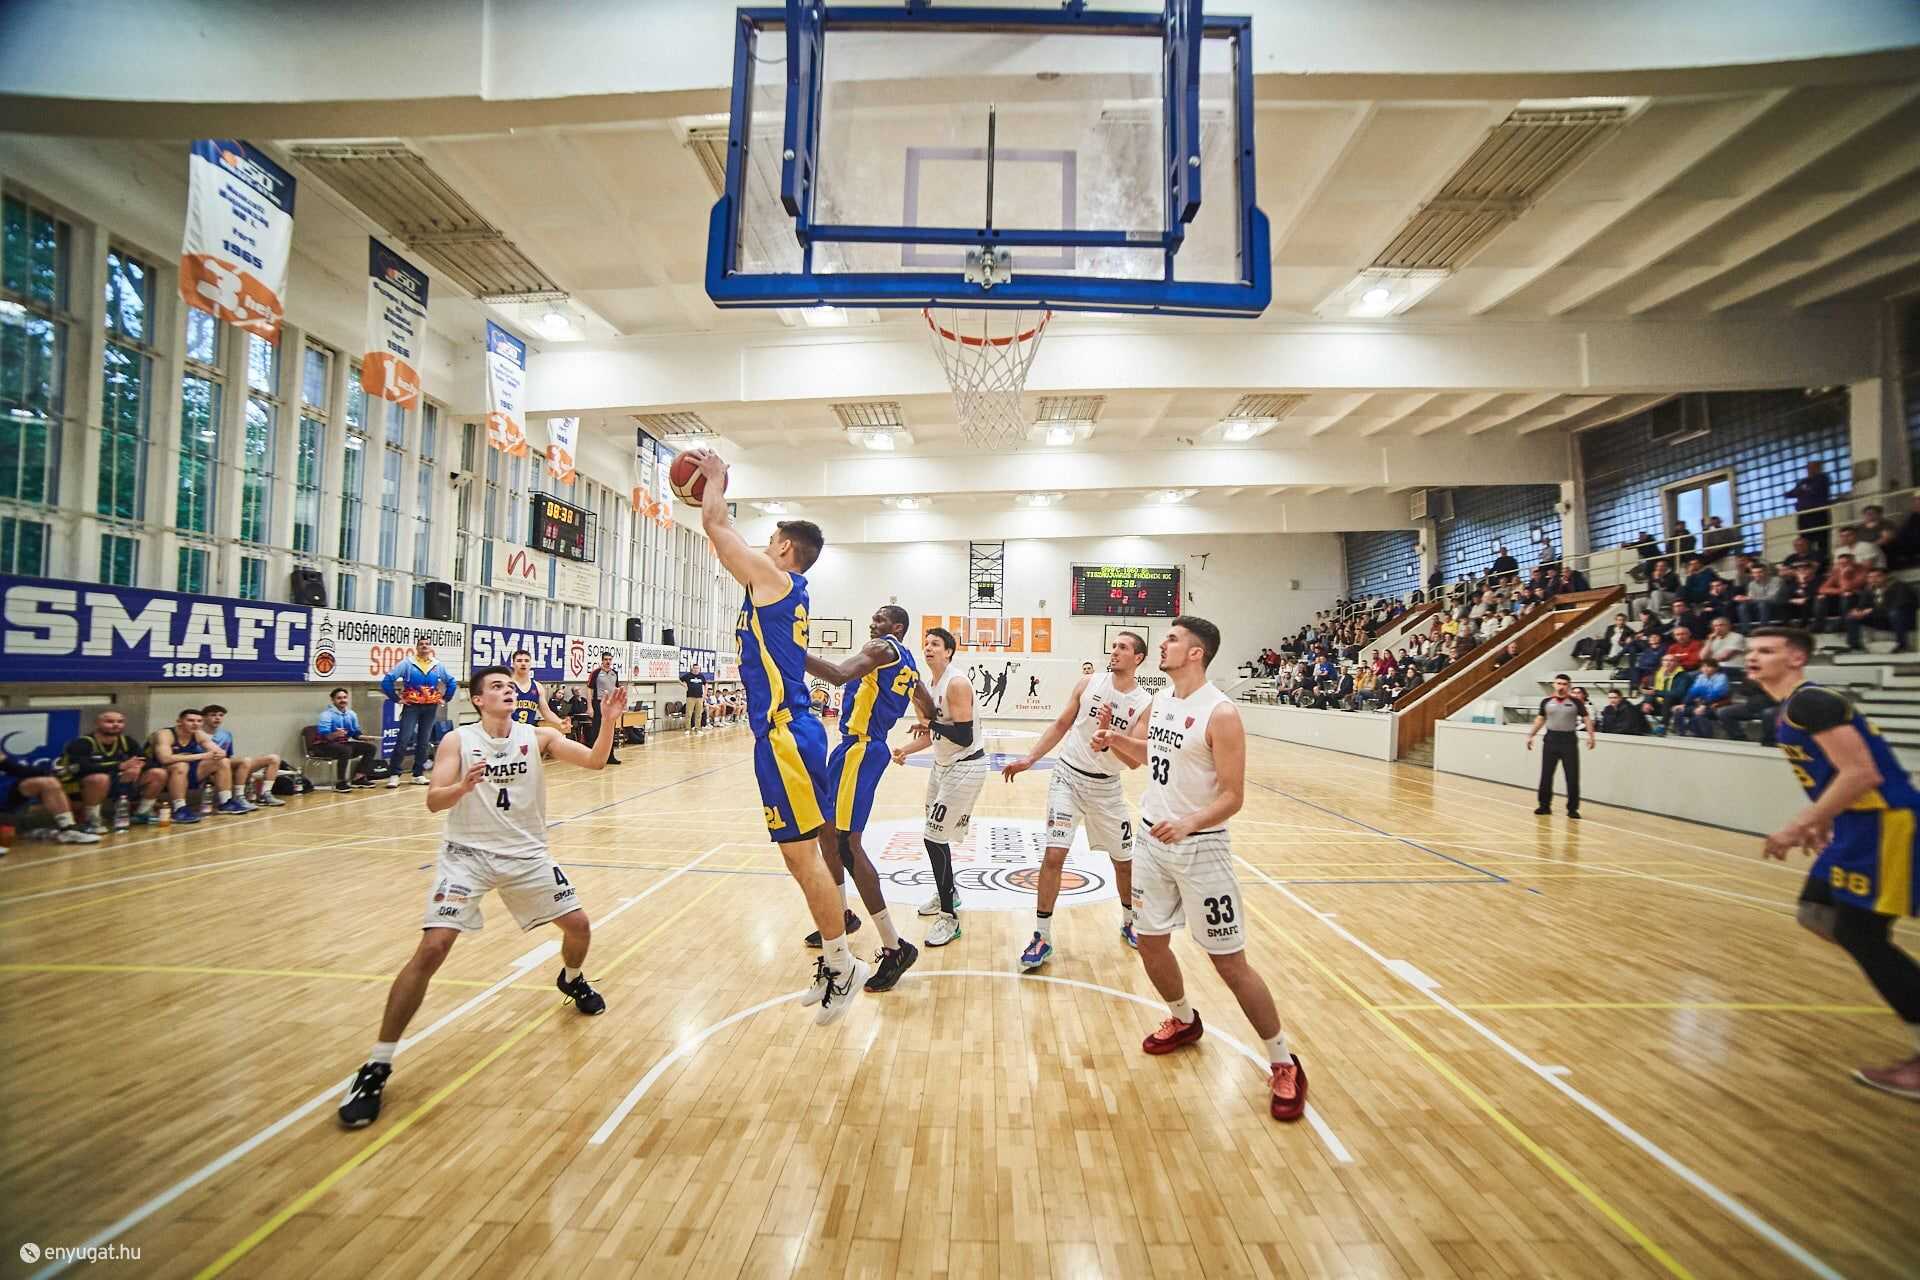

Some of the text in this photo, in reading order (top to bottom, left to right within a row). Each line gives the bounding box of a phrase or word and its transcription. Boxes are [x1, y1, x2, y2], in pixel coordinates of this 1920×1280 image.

[4, 585, 307, 661] SMAFC
[338, 620, 410, 644] KOSÁRLABDA
[473, 630, 564, 669] SMAFC
[162, 663, 224, 677] 1860
[480, 762, 527, 777] MAFC
[1152, 756, 1170, 785] 33
[496, 788, 511, 811] 4
[931, 803, 948, 823] 10
[552, 866, 569, 887] 4
[1203, 894, 1235, 925] 33
